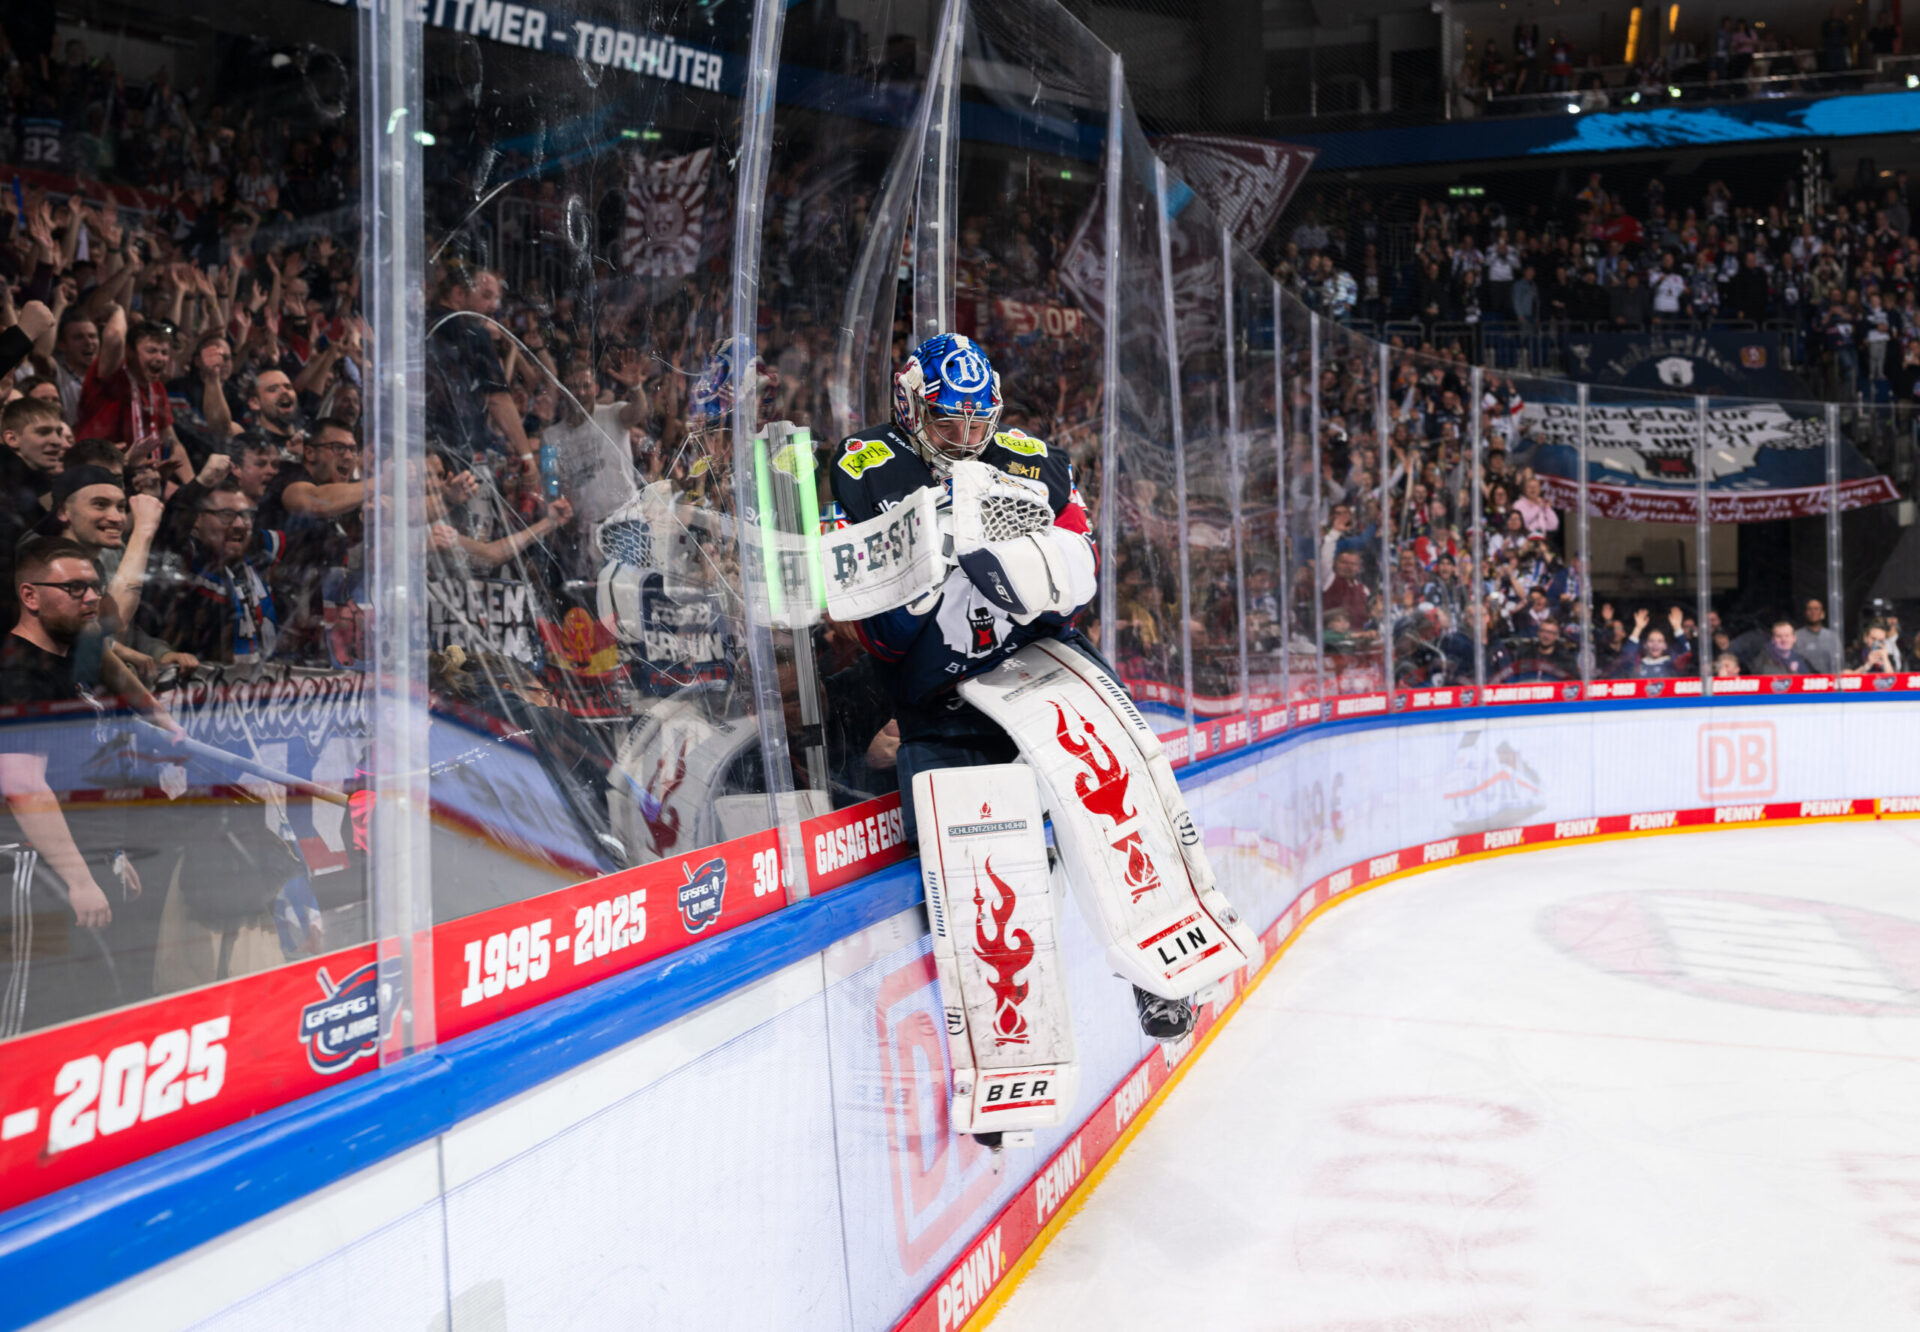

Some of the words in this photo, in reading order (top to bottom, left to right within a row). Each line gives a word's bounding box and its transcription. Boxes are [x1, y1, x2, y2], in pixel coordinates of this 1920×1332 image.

[357, 0, 547, 50] ETTMER
[573, 21, 723, 91] TORHÜTER
[24, 136, 61, 162] 92
[845, 446, 889, 474] Karls
[1029, 465, 1041, 480] 11
[1707, 734, 1768, 788] DB
[1880, 798, 1920, 812] PENN
[815, 820, 867, 876] GASAG
[865, 816, 880, 855] &
[752, 848, 779, 898] 30
[680, 883, 710, 902] GASAG
[1157, 926, 1207, 965] LIN
[305, 995, 368, 1029] GASAG
[986, 1079, 1049, 1103] BER
